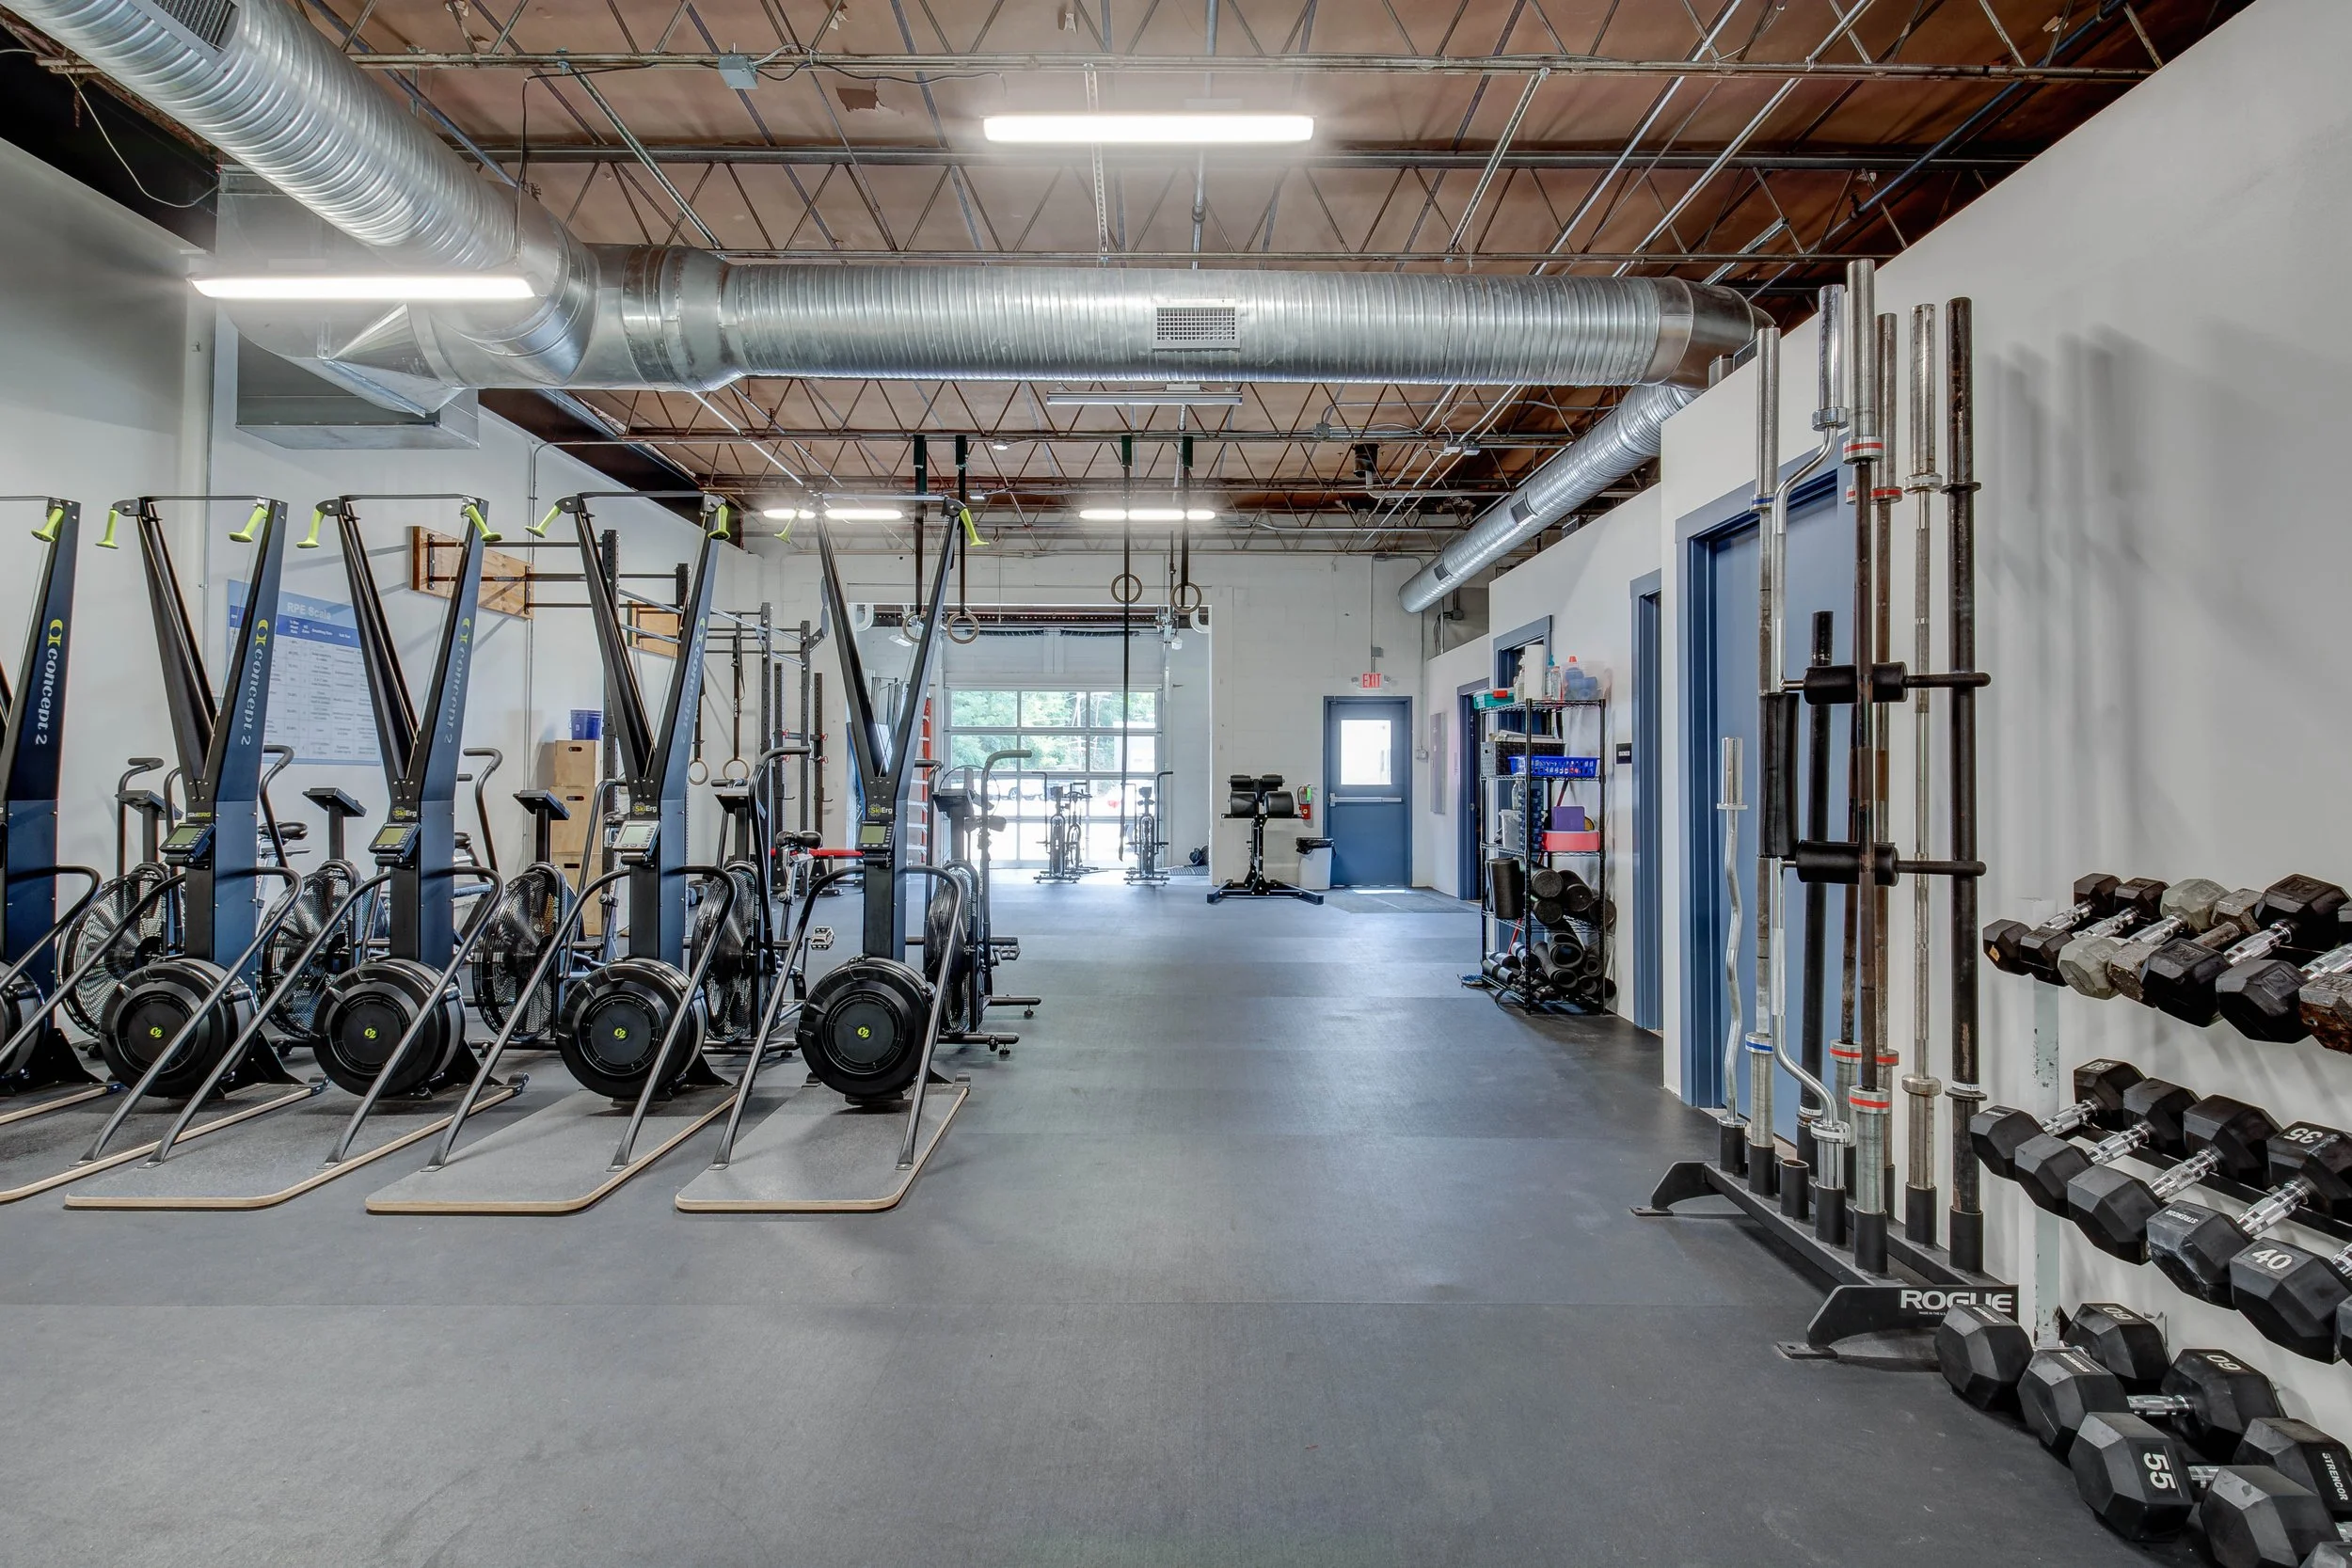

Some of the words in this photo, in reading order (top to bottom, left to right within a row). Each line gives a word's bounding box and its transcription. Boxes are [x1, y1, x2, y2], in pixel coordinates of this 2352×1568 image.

[287, 602, 306, 614] RPE
[308, 606, 331, 621] Scale
[446, 646, 466, 729] concept
[1362, 673, 1381, 688] EXIT
[38, 648, 57, 730] concept
[244, 648, 263, 730] concept
[35, 734, 48, 745] 2
[241, 735, 251, 746] 2
[444, 734, 453, 744] 2
[635, 804, 657, 814] SkiErg
[870, 806, 893, 815] SkiErg
[2087, 1061, 2112, 1070] 30
[2283, 1128, 2323, 1144] 35
[2165, 1210, 2199, 1224] STRENCOR
[2251, 1248, 2293, 1270] 40
[1900, 1290, 2012, 1312] ROGUE
[2102, 1307, 2134, 1320] 60
[2206, 1354, 2242, 1370] 60
[2143, 1452, 2176, 1490] 55
[2322, 1452, 2348, 1501] STRENCOR
